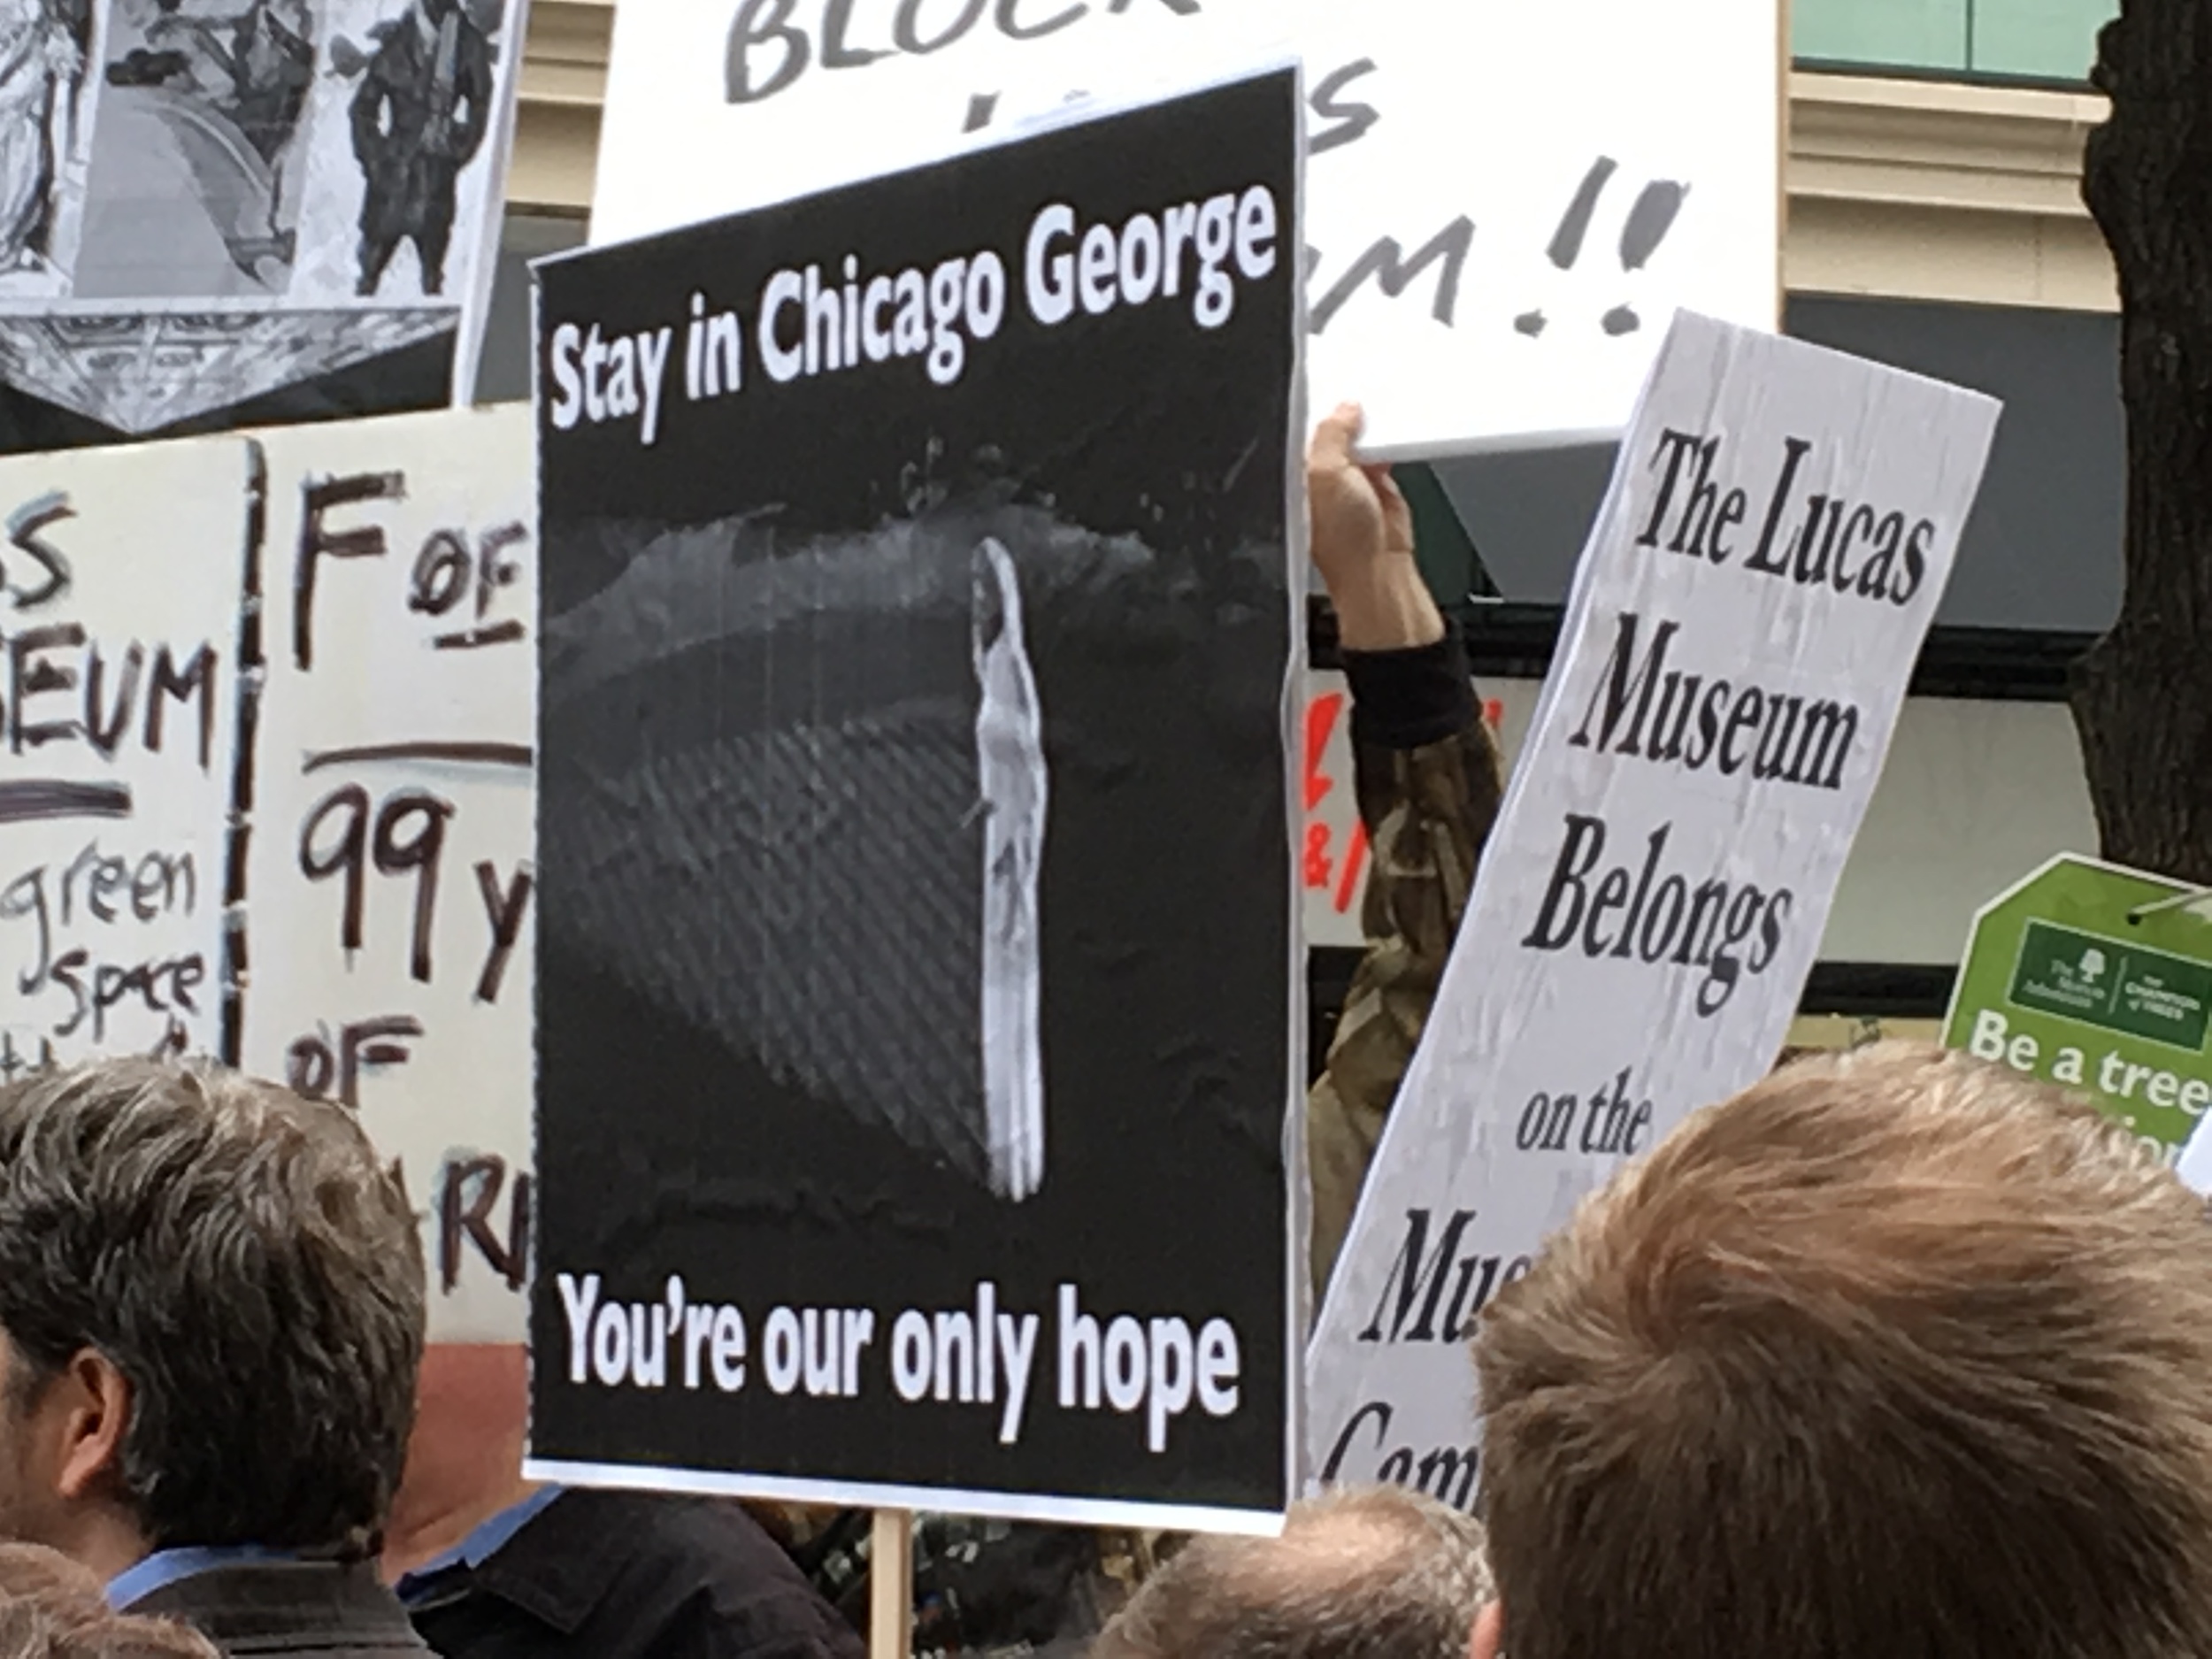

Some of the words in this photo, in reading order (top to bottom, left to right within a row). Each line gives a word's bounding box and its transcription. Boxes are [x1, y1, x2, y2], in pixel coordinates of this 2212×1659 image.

[550, 322, 672, 445] Stay
[686, 291, 741, 401] in
[758, 255, 1006, 384] Chicago
[1025, 184, 1277, 328] George
[1637, 427, 1747, 565] The
[1744, 437, 1936, 606] Lucas
[0, 622, 219, 777] EUM
[1569, 612, 1860, 791] Museum
[0, 838, 196, 995] green
[299, 783, 455, 984] 99
[1522, 812, 1792, 1018] Belongs
[1516, 1091, 1578, 1151] on
[1579, 1065, 1652, 1155] the
[1970, 1009, 2039, 1071] Be
[2052, 1047, 2084, 1085] a
[2099, 1049, 2211, 1116] tree
[1356, 1209, 1532, 1345] Mu
[763, 1303, 874, 1397] our
[892, 1280, 1040, 1443] only
[1059, 1283, 1240, 1453] hope
